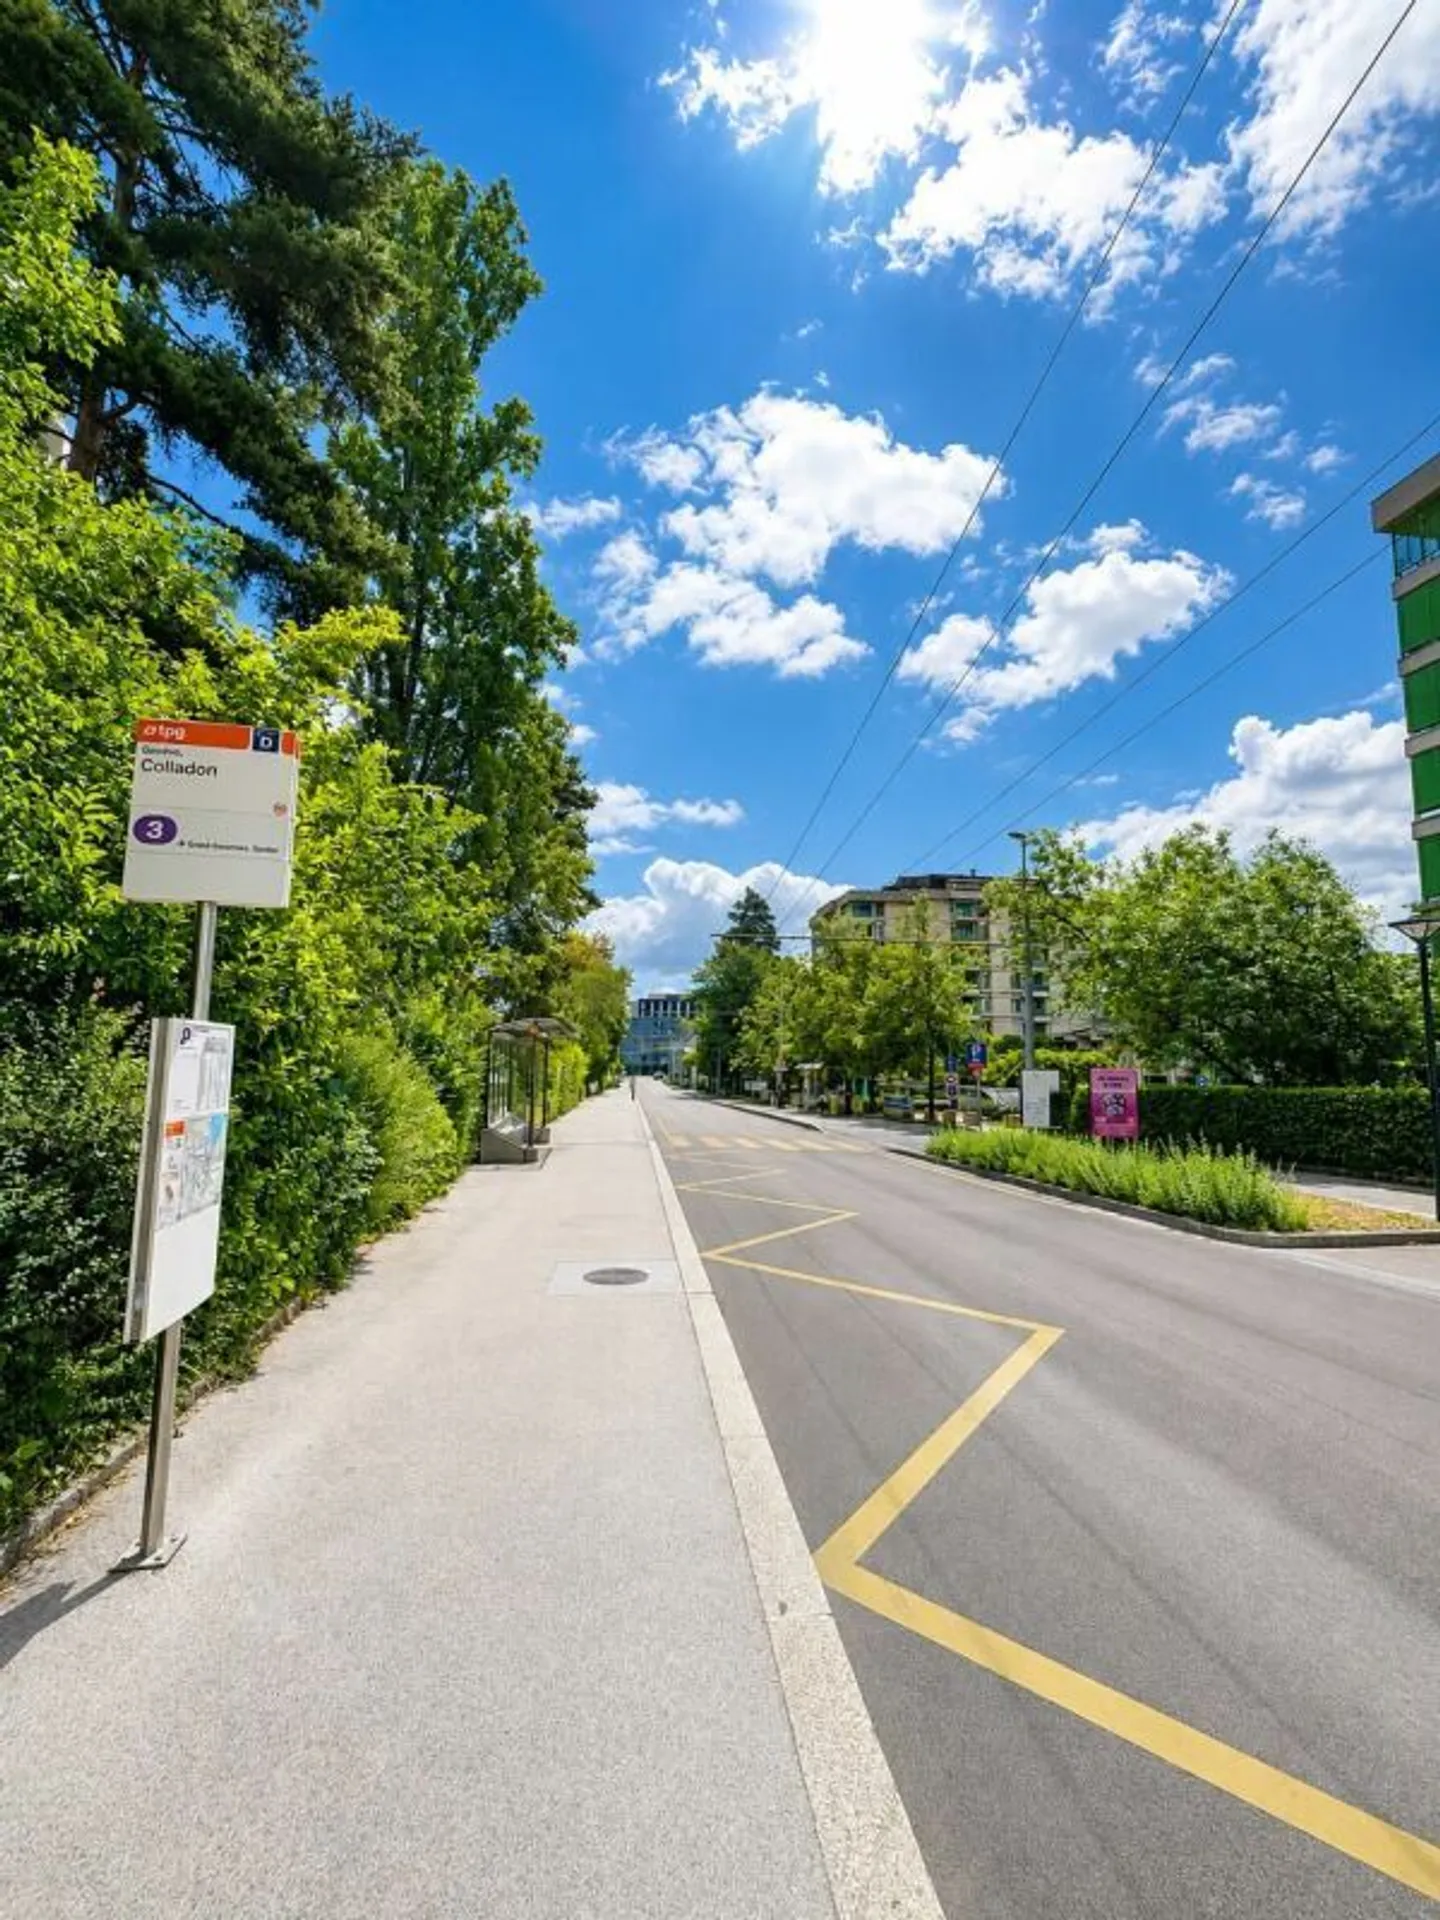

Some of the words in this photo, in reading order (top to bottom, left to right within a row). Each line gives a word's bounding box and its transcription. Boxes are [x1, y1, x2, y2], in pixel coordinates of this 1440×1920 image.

[159, 724, 186, 740] tpg
[260, 736, 273, 748] D
[141, 758, 218, 778] Colladon
[145, 820, 164, 839] 3
